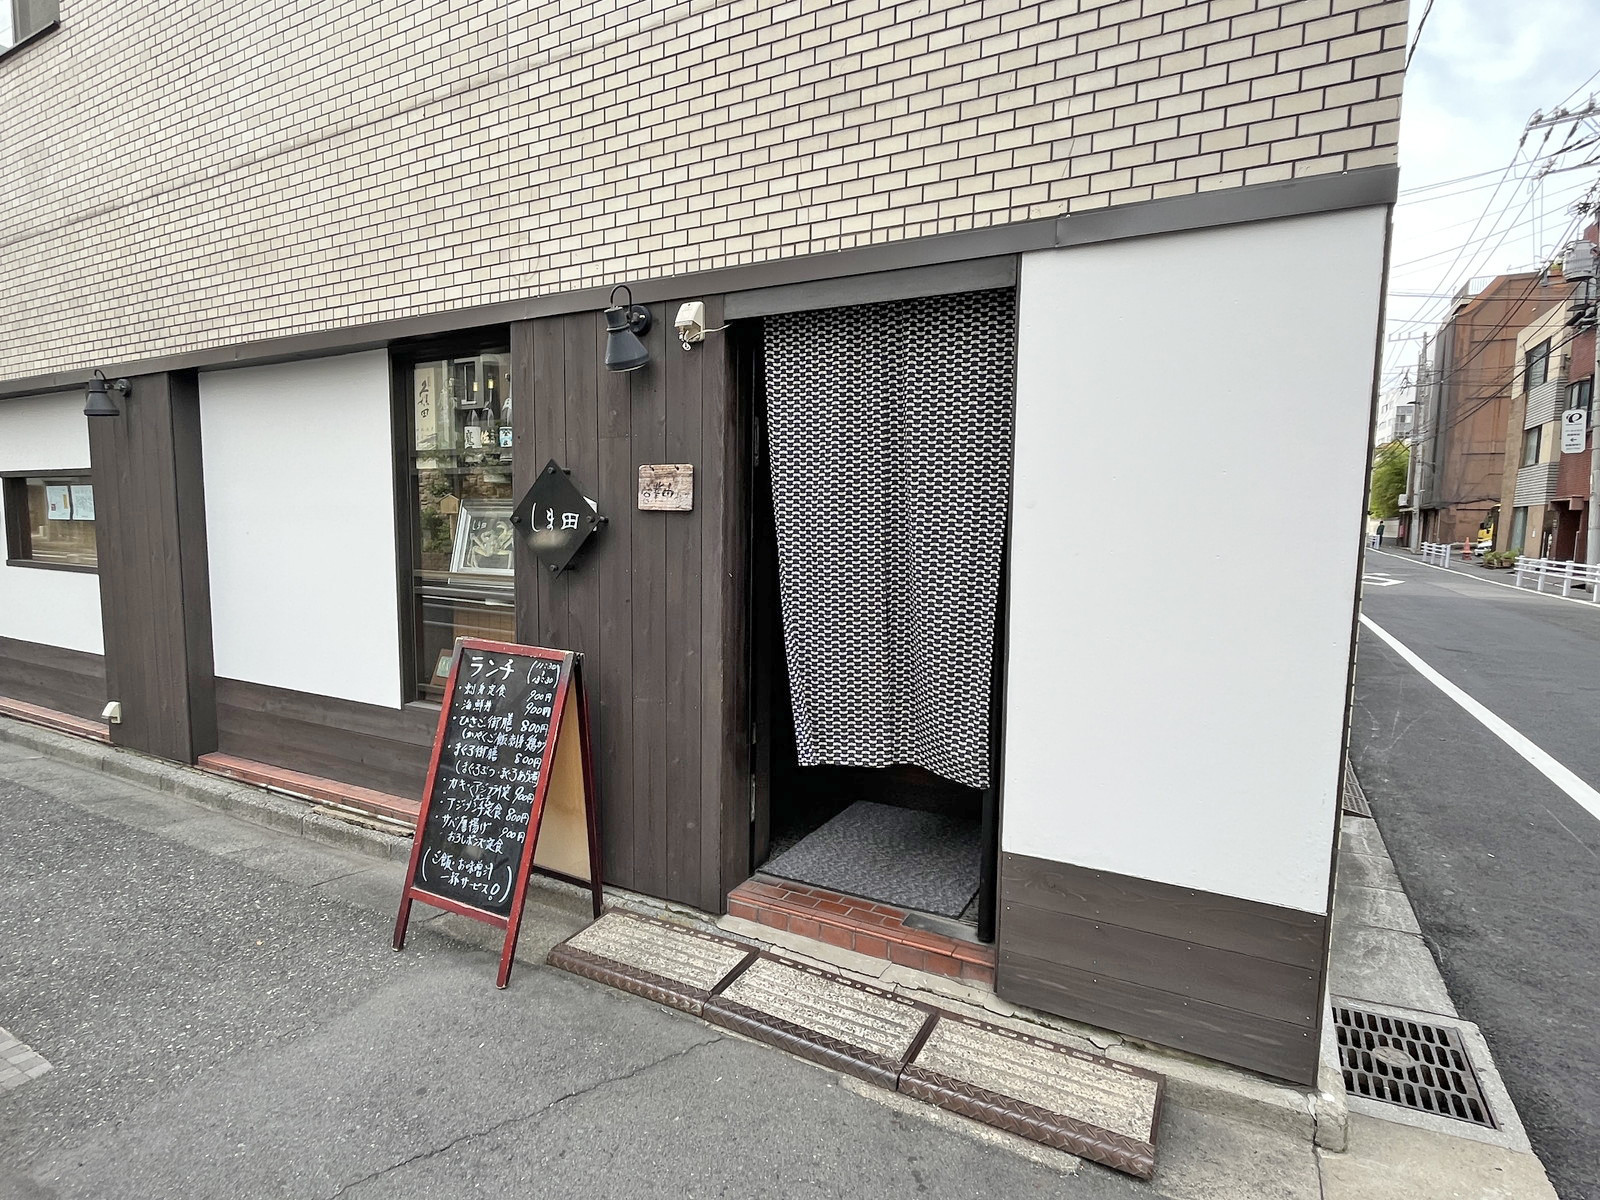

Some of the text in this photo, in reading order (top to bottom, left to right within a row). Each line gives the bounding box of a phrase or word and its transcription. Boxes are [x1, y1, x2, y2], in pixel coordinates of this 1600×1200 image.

[530, 502, 580, 533] しま田
[470, 656, 515, 681] ランチ
[463, 681, 553, 703] 刺身定食 900円
[524, 702, 551, 718] 900円
[520, 719, 549, 736] 800円
[453, 741, 542, 770] まぐろ御膳 800円
[512, 786, 535, 804] 900円
[505, 807, 530, 826] 800円
[441, 813, 526, 844] サバ唐揚げ 900円
